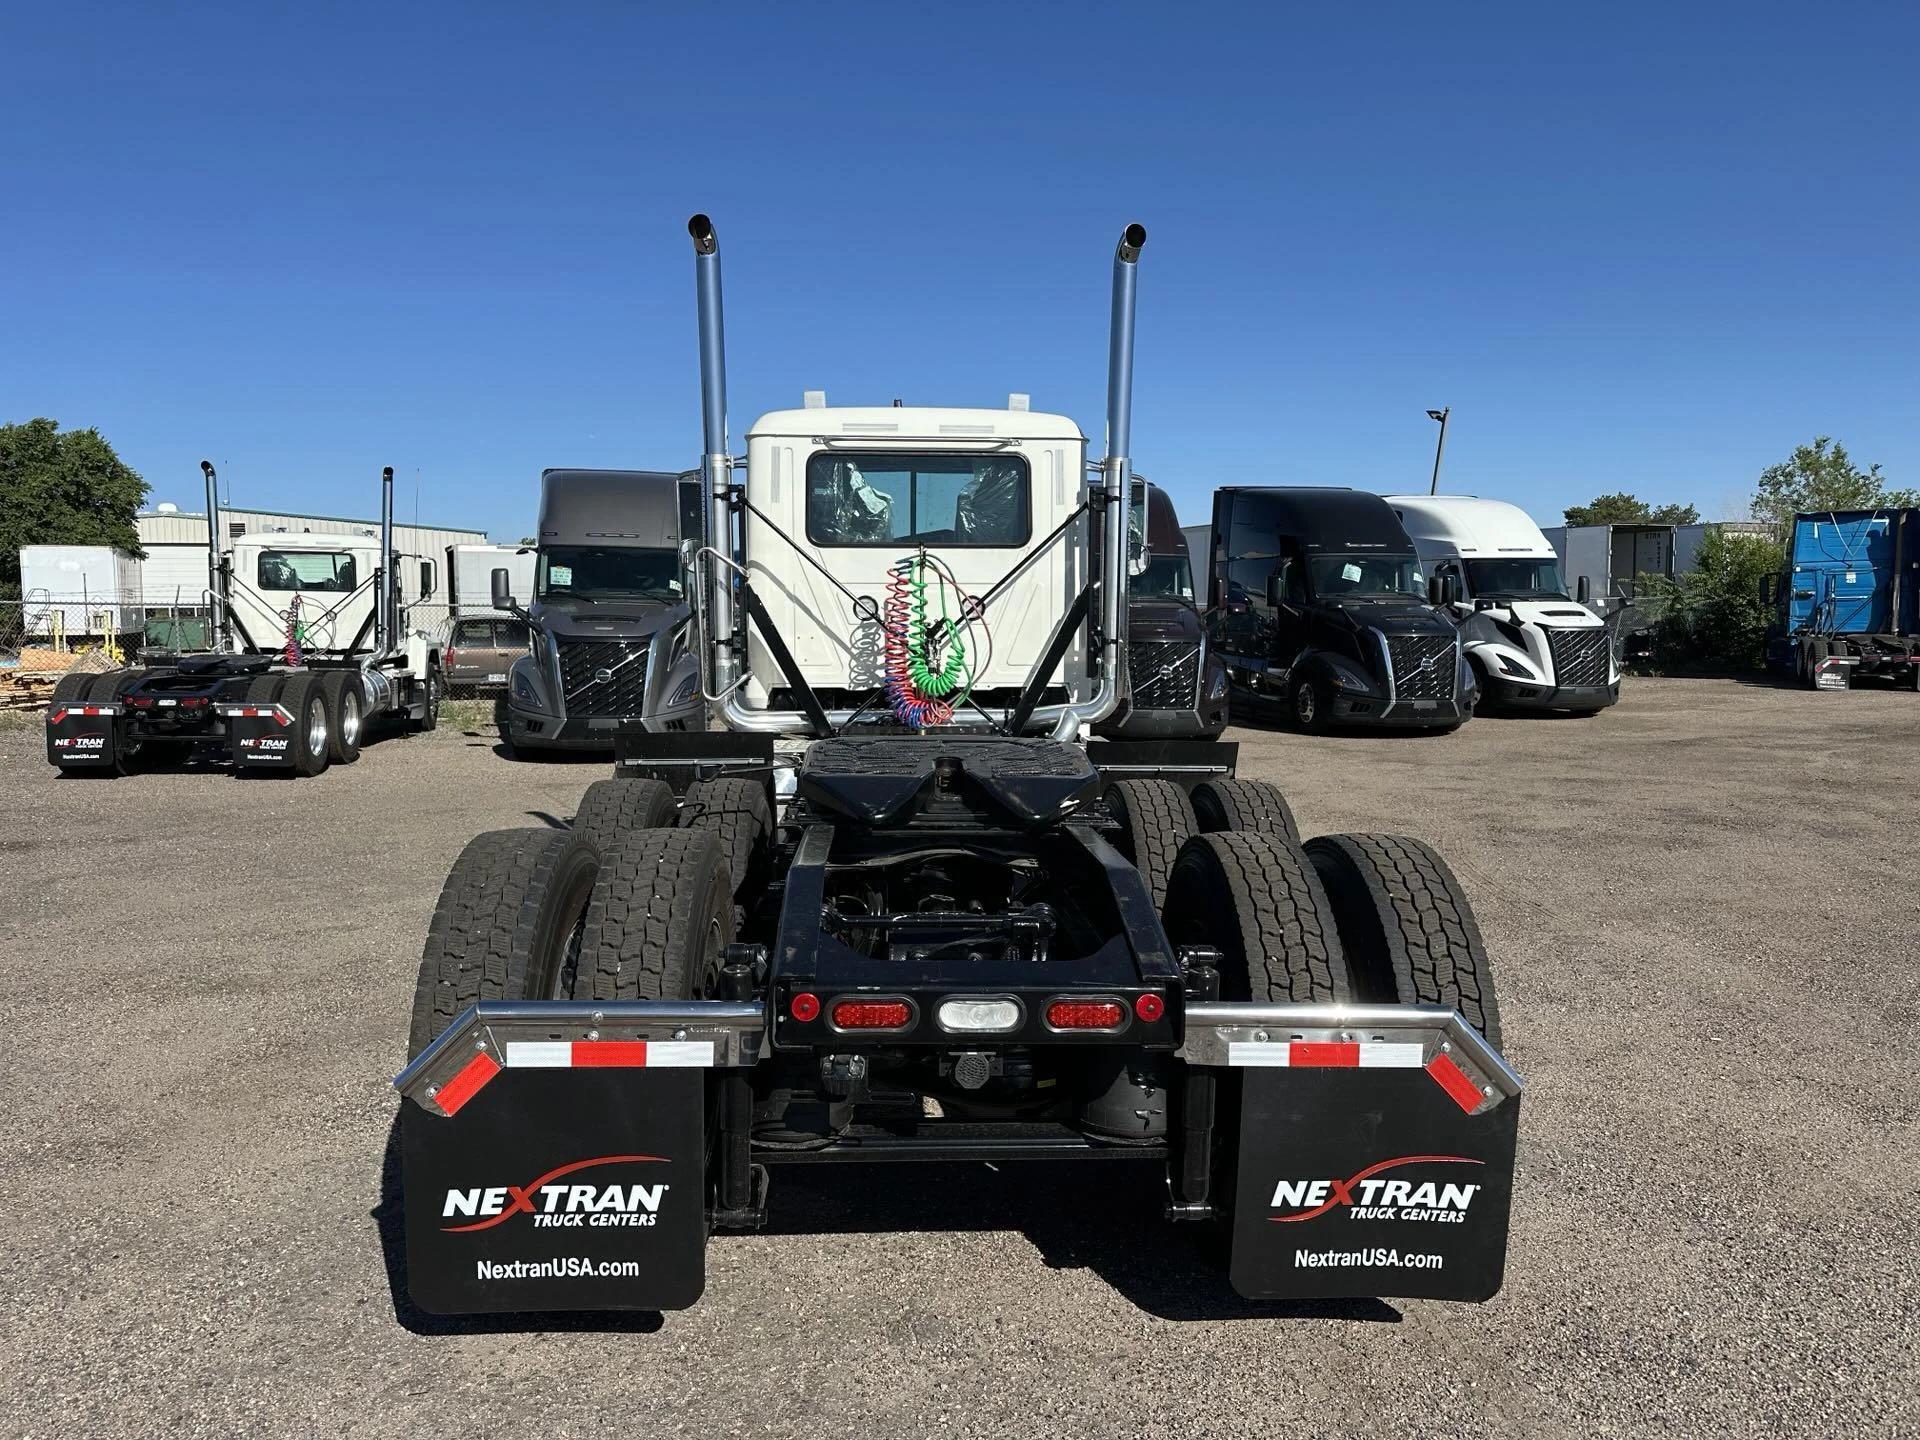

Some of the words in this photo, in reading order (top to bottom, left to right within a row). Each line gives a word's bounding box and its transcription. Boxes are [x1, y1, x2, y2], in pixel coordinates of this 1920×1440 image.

[55, 738, 105, 746] NEXTRAN
[240, 739, 288, 747] NEXTRAN
[442, 1184, 664, 1217] NEXTRAN
[1270, 1180, 1476, 1210] NEXTRAN
[533, 1214, 586, 1228] TRUCK
[589, 1213, 658, 1227] CENTERS
[1350, 1206, 1397, 1220] TRUCK
[1400, 1208, 1467, 1223] CENTERS
[477, 1257, 640, 1280] NextranUSA.com
[1294, 1248, 1444, 1270] NextranUSA.com
